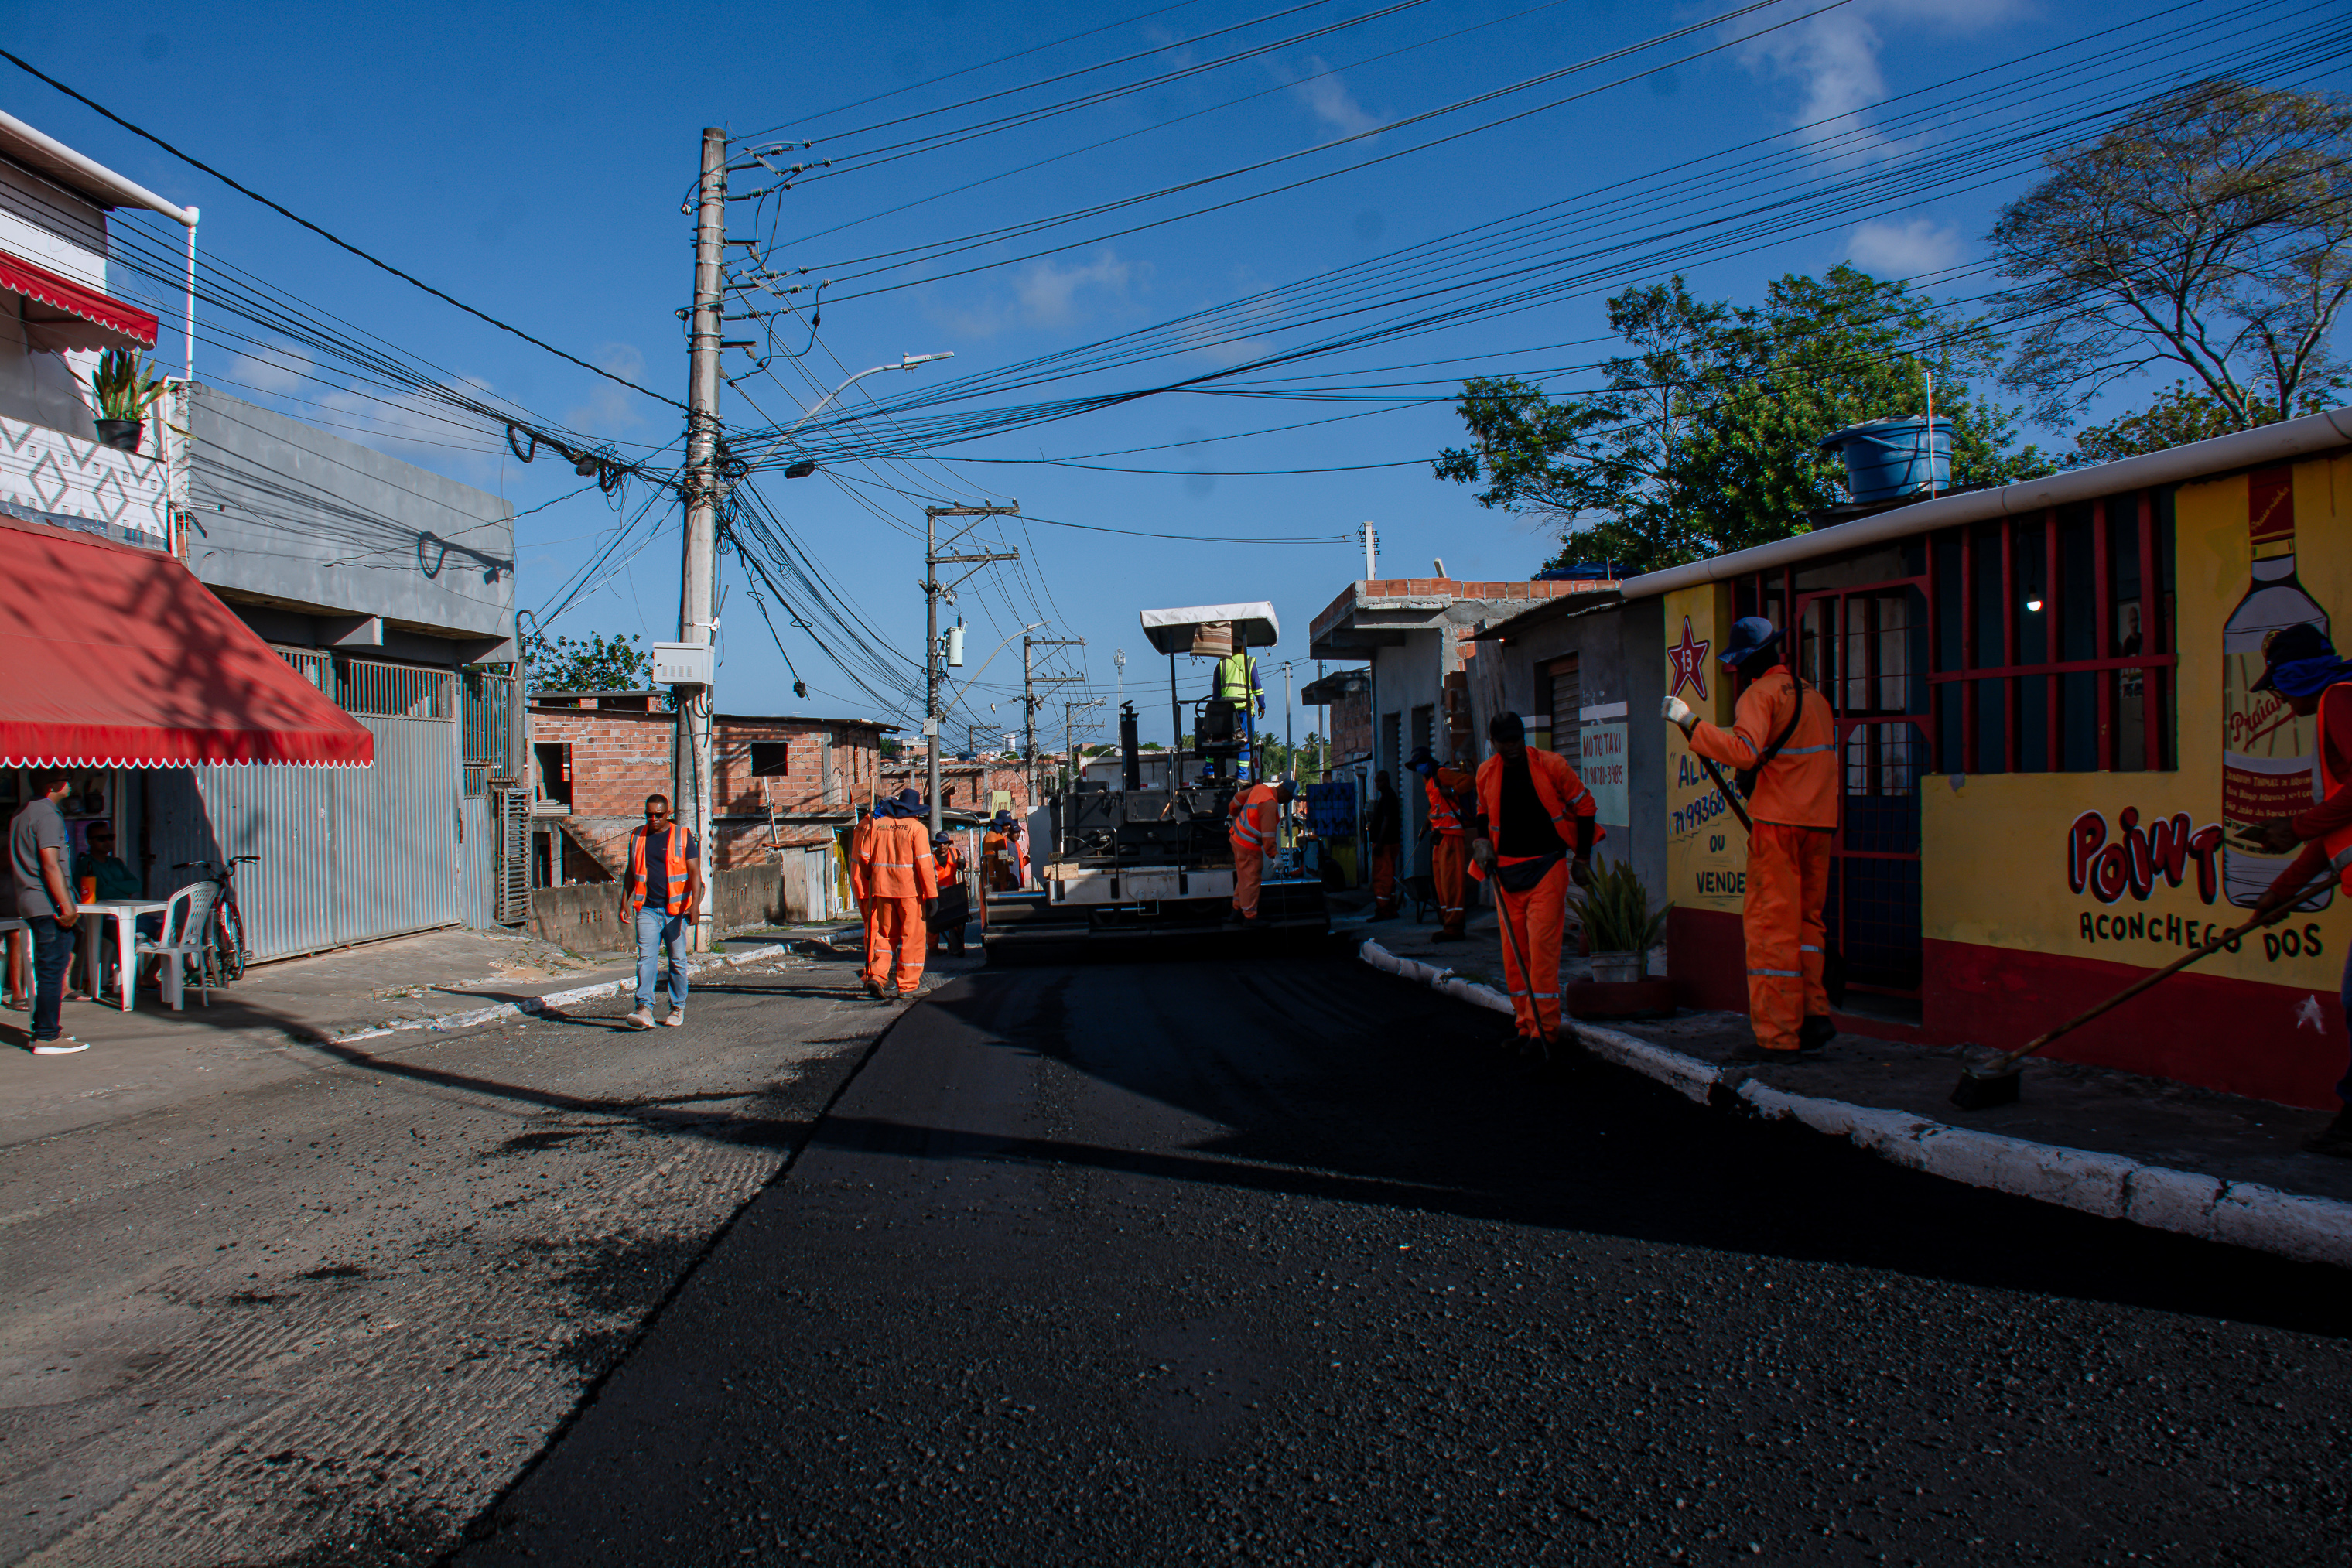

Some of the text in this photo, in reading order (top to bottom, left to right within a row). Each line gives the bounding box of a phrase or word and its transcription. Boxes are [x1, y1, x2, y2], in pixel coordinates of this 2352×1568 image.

[1680, 649, 1693, 673] 13
[1709, 834, 1725, 853] OU
[1696, 870, 1746, 894] VENDE
[2080, 911, 2323, 962] ACONCHEGO DOS
